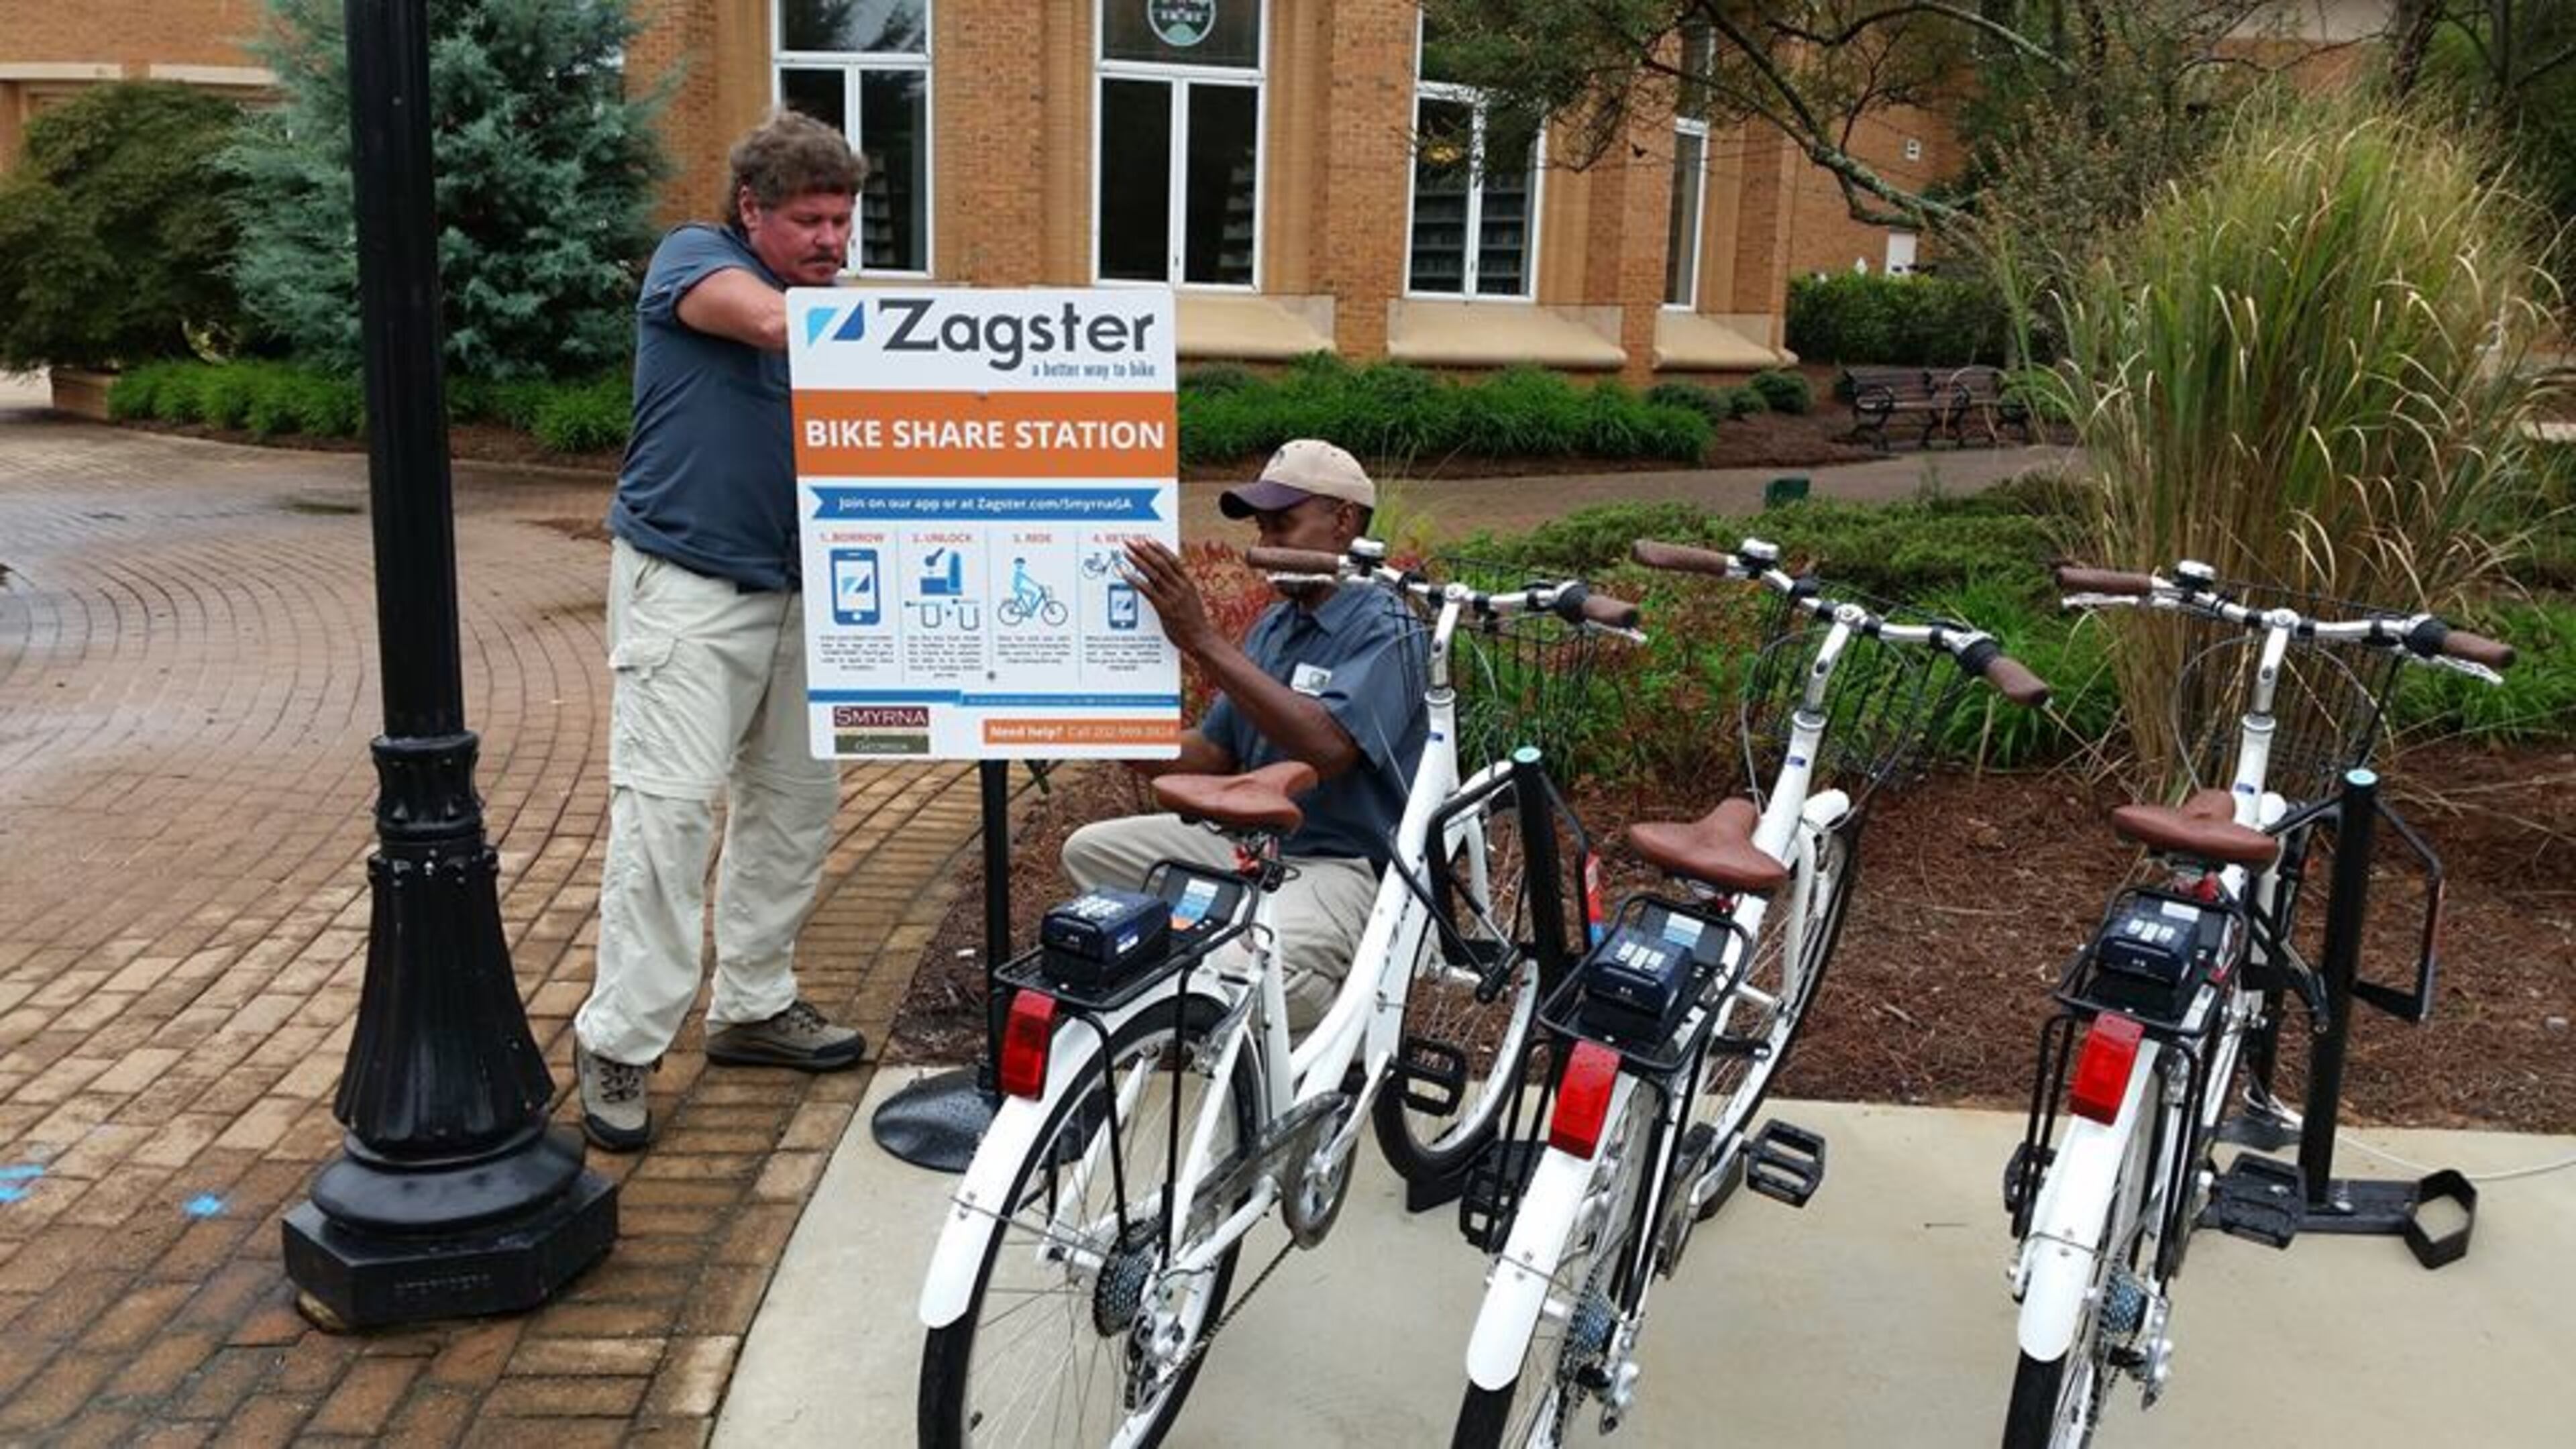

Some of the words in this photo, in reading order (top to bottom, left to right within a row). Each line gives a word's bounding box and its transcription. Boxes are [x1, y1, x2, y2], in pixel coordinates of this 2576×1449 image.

[878, 299, 1155, 371] Zagster
[1032, 364, 1039, 377] a
[1043, 360, 1079, 377] better
[1083, 364, 1109, 381] way
[1113, 364, 1126, 377] to
[1129, 360, 1155, 377] bike
[806, 419, 883, 448] BIKE
[892, 419, 1005, 449] SHARE
[1014, 420, 1165, 449] STATION
[839, 496, 865, 511] Join
[868, 498, 886, 509] on
[888, 498, 912, 509] our
[914, 498, 938, 513] app
[941, 498, 957, 509] or
[959, 498, 973, 509] at
[837, 707, 926, 726] SMYRNA
[989, 726, 1025, 737] Need
[1027, 726, 1064, 740] help?
